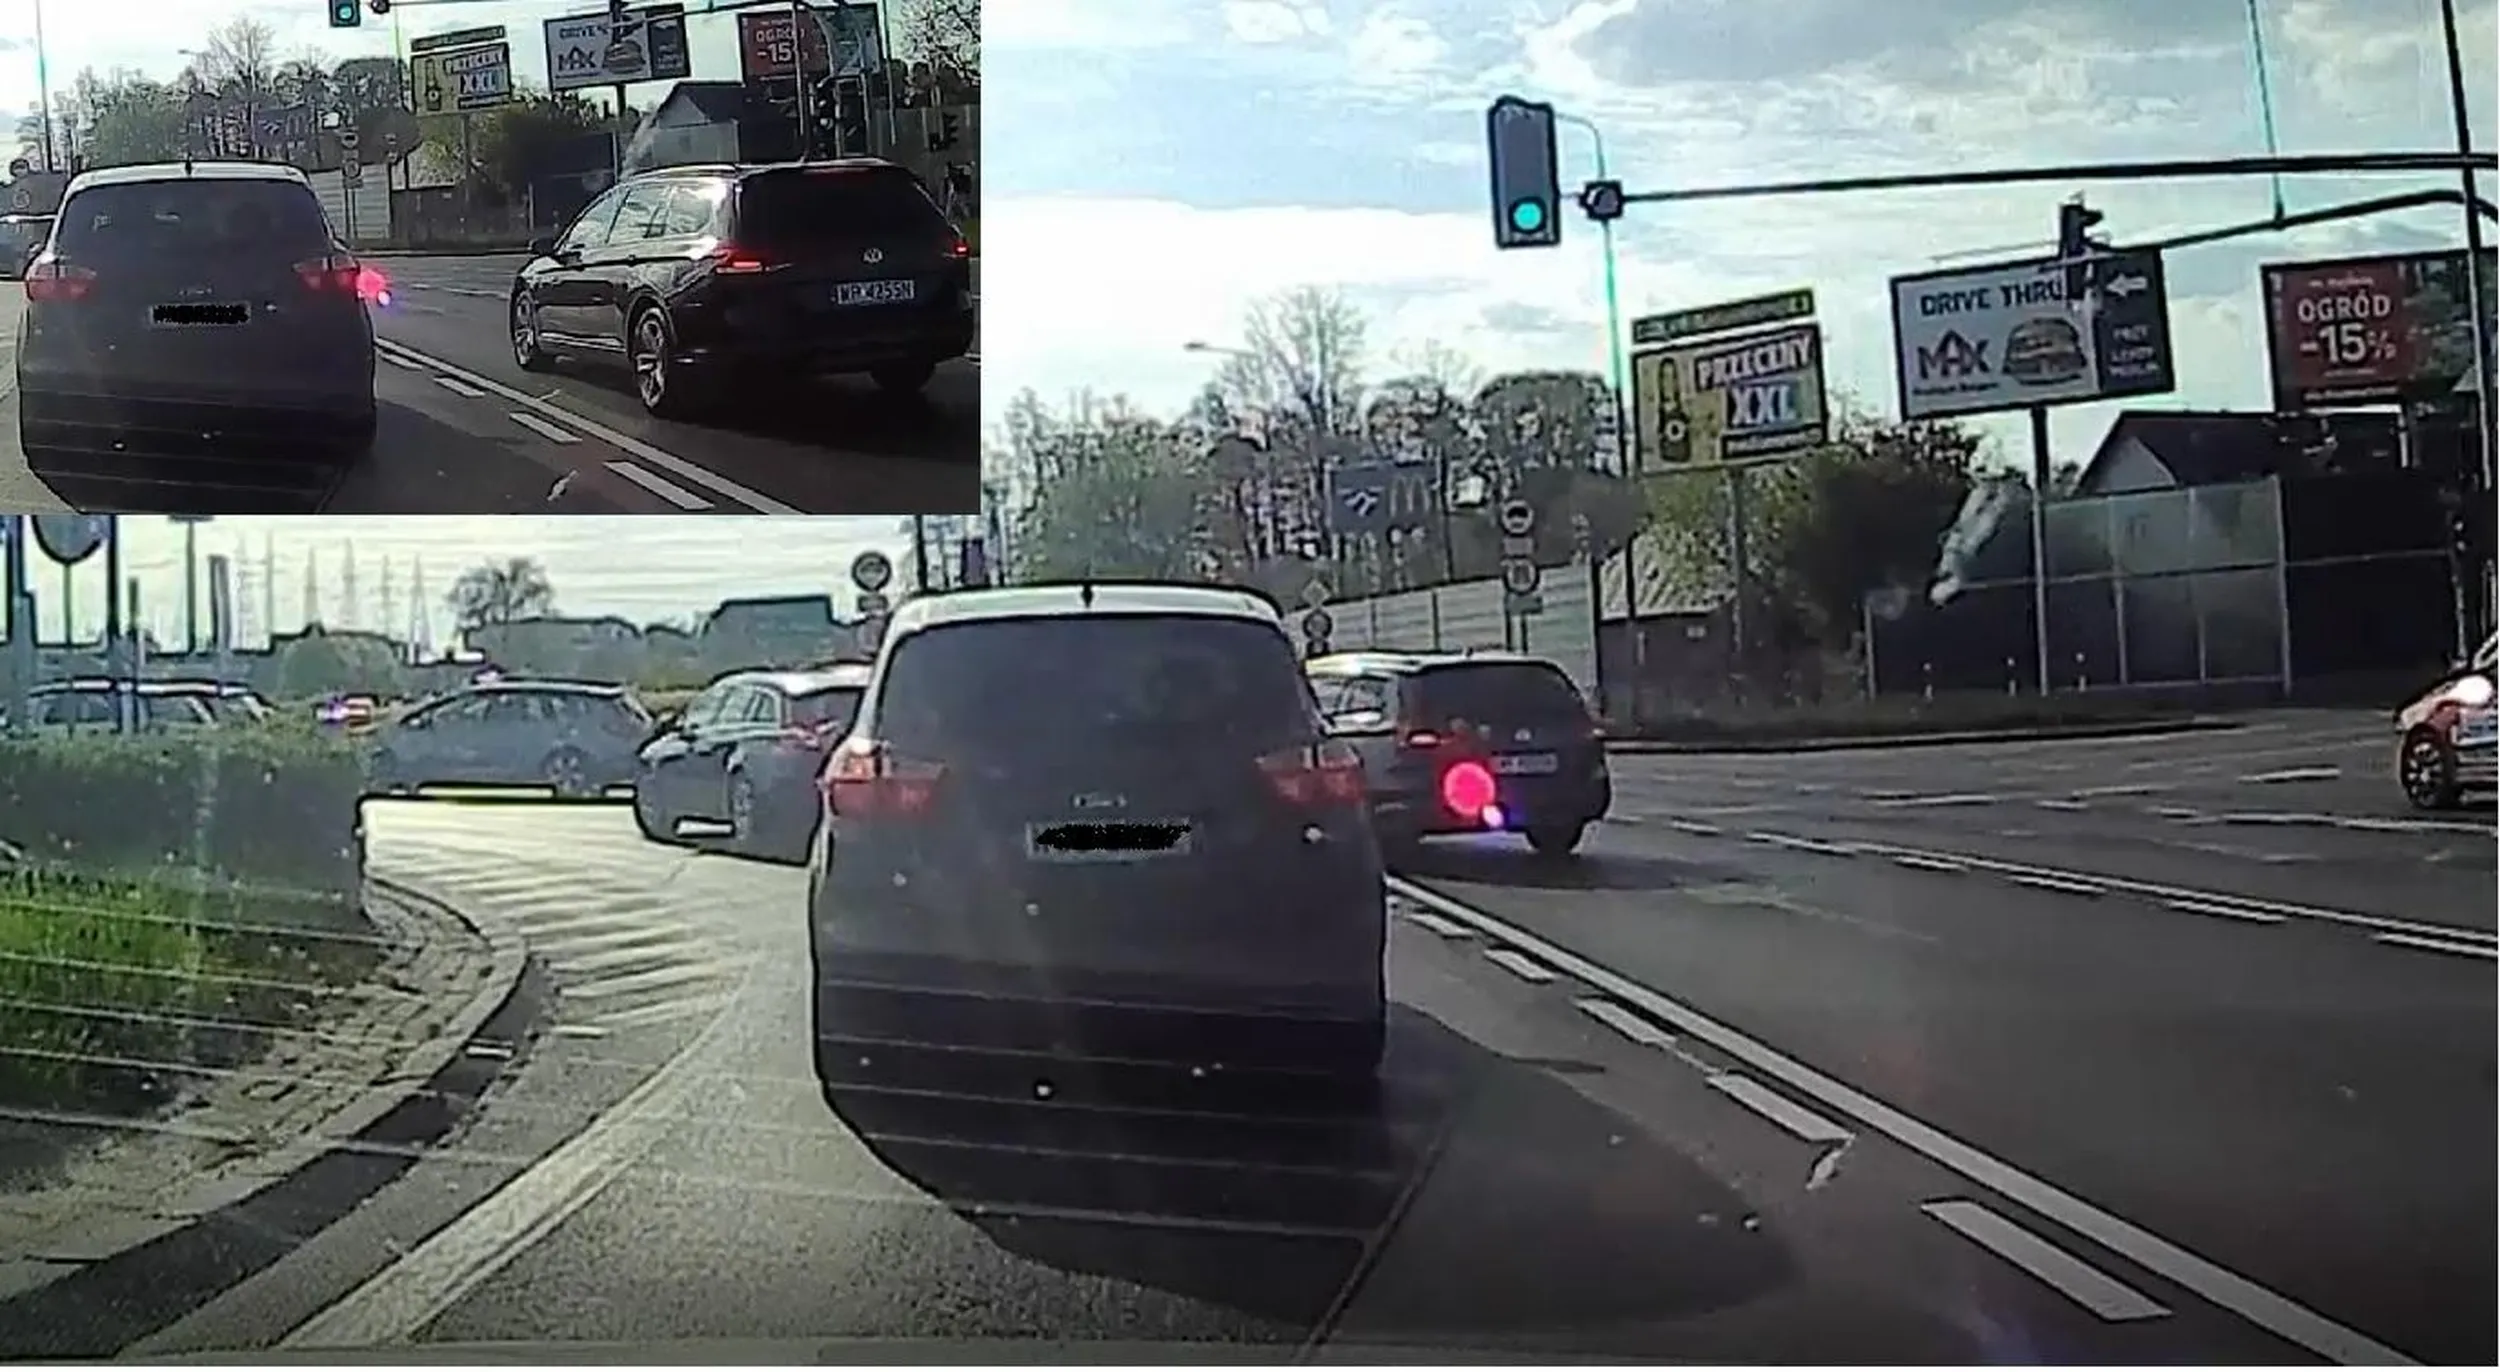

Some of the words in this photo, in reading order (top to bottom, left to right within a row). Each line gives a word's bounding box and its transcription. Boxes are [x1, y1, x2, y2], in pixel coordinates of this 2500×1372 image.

[463, 70, 497, 95] XXL
[1920, 287, 1991, 316] DRIVE
[2000, 277, 2062, 308] THRU
[2297, 288, 2392, 323] OGRÓD
[1917, 328, 1992, 380] MAX
[2300, 322, 2397, 364] -15%
[1731, 385, 1796, 426] XXL
